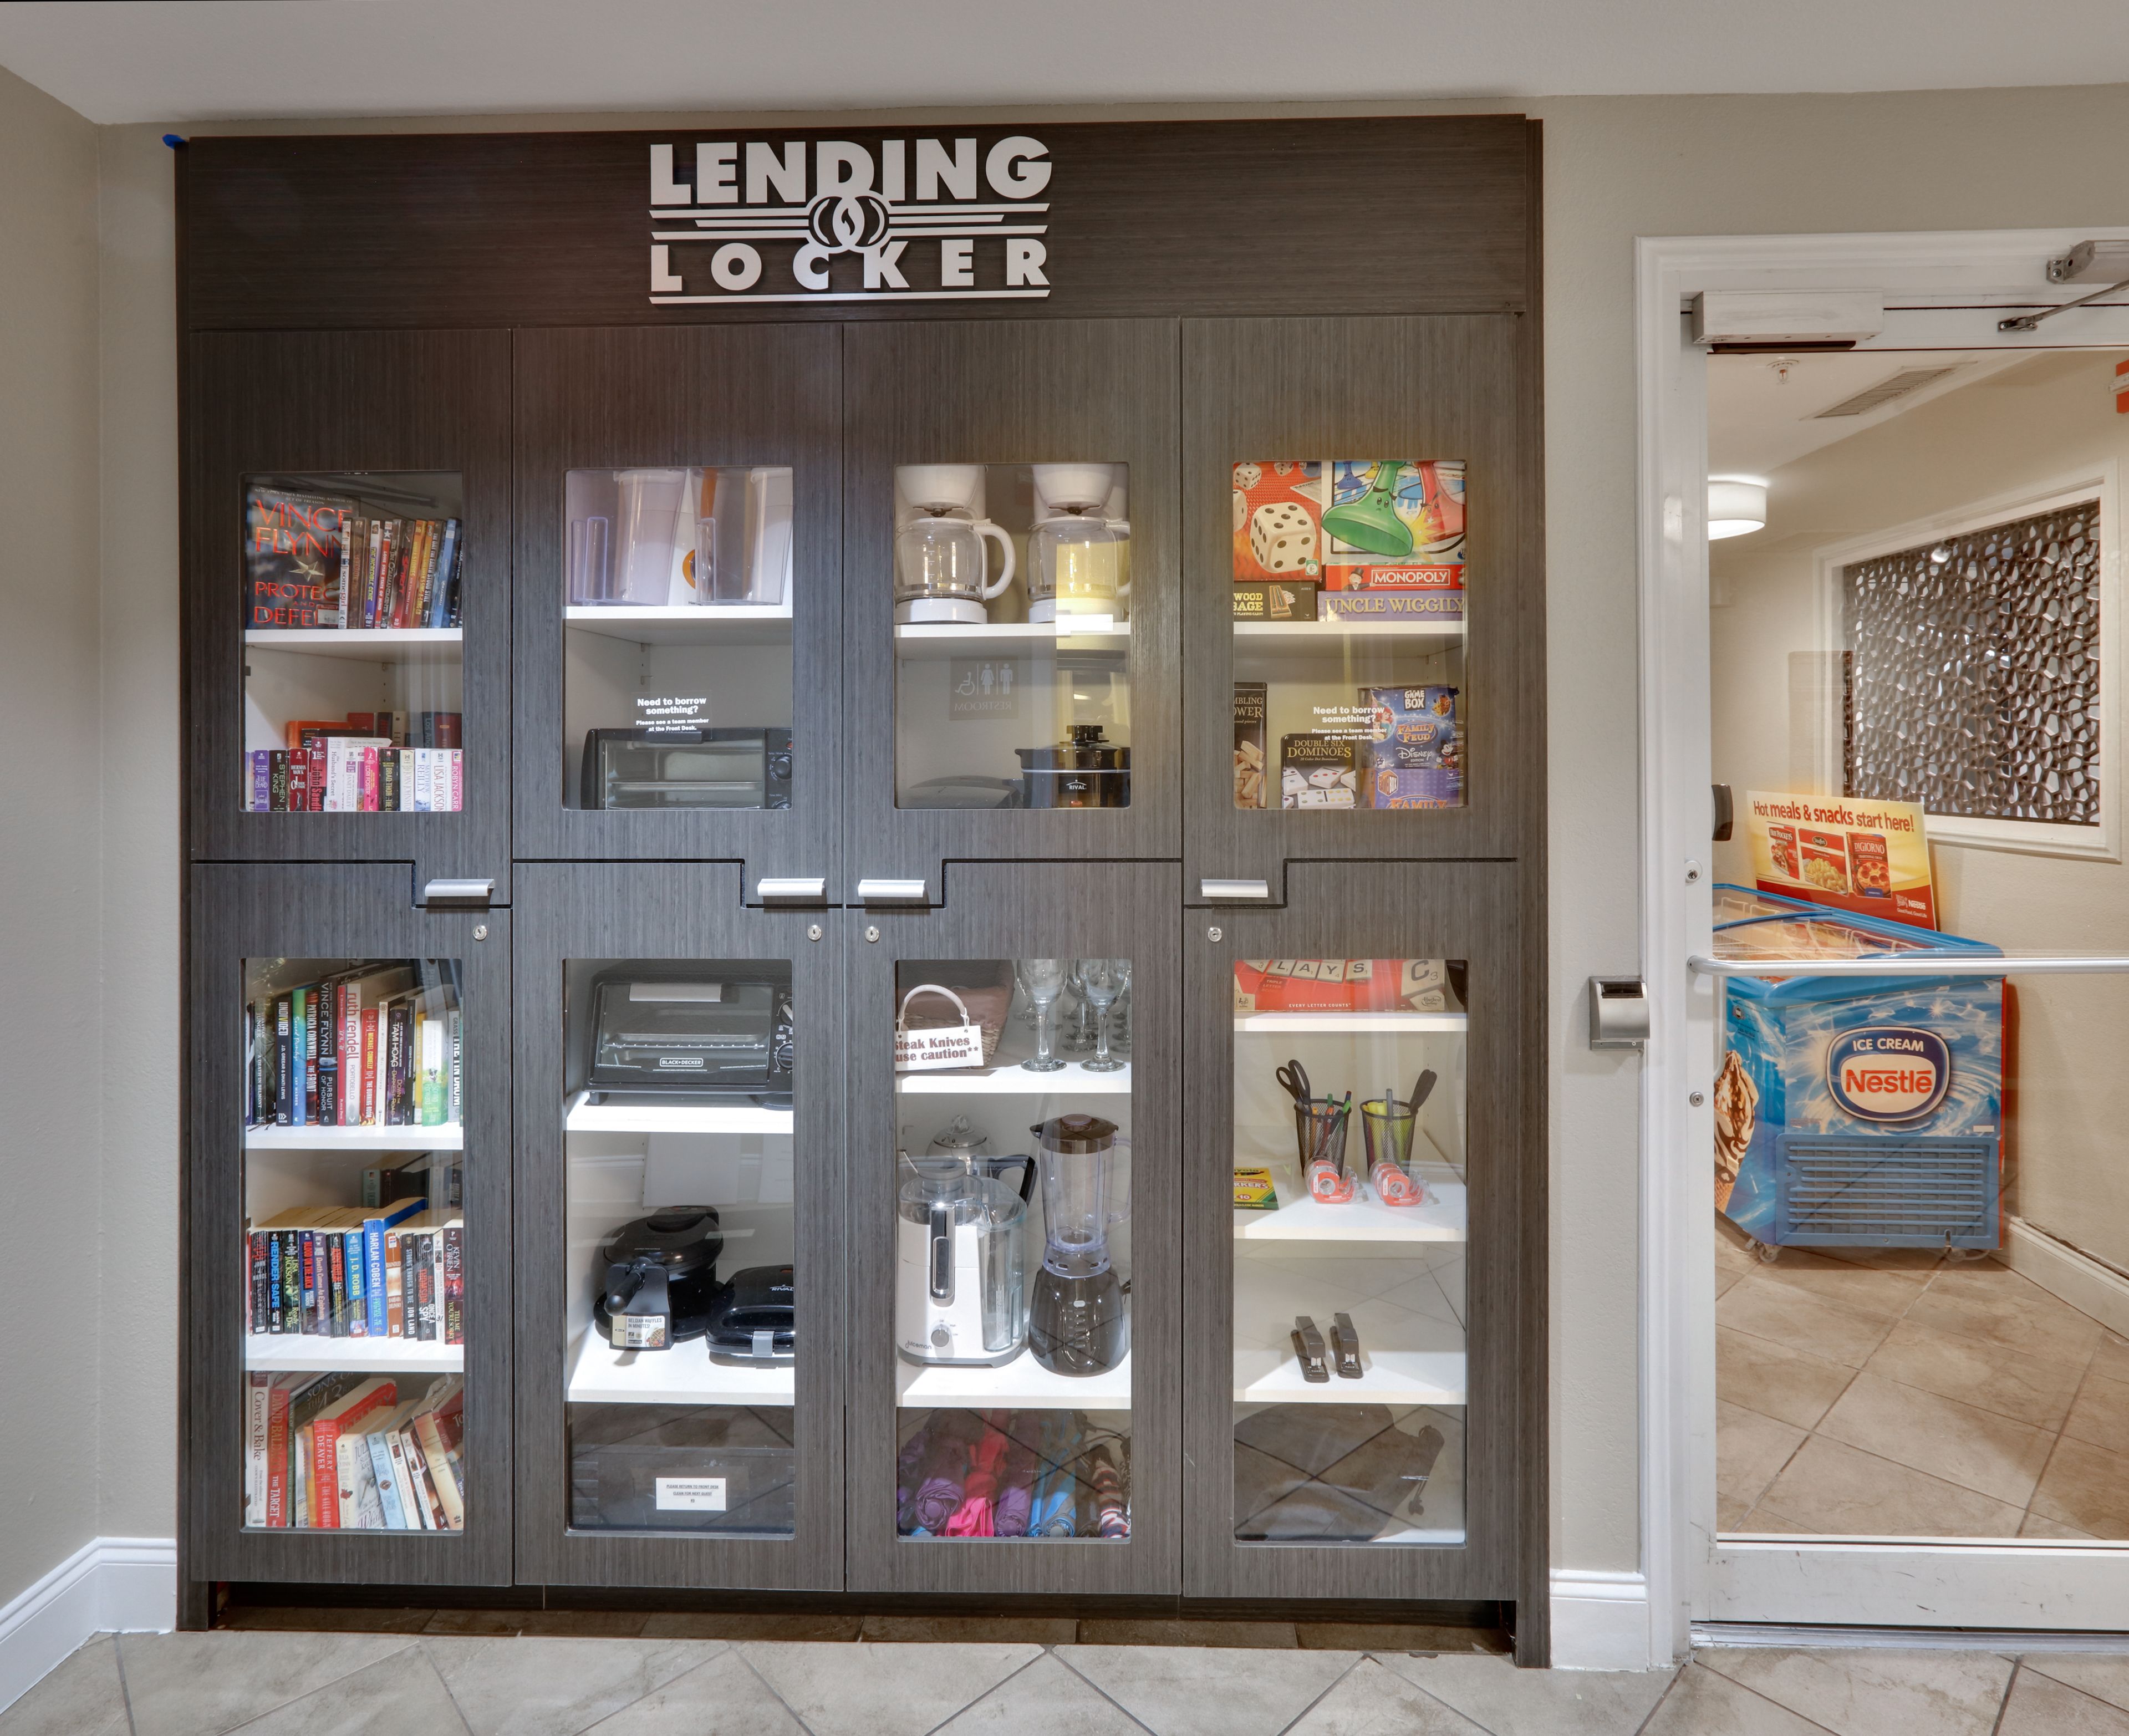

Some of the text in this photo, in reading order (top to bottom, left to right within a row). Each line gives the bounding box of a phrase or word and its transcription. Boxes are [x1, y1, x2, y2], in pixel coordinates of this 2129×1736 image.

[650, 136, 1052, 205] LENDING
[651, 237, 1051, 292] LOCKER
[425, 574, 434, 590] STOOD
[1374, 572, 1448, 584] MONOPOLY
[1234, 593, 1263, 601] WOOD
[1325, 597, 1464, 614] UNCLE WIGGILY
[638, 698, 661, 706] Need
[646, 705, 699, 715] something?
[1405, 698, 1424, 710] BOX
[1322, 715, 1376, 724] something?
[1397, 725, 1435, 735] FAMILY
[1403, 732, 1430, 742] FEUD
[1287, 746, 1352, 758] DOMINOES
[312, 767, 323, 786] John
[434, 765, 445, 811] LISA JACKSON
[1754, 800, 1914, 832] Hot meals & snacks start here!
[278, 1002, 288, 1036] UNDIVIDED
[307, 1004, 317, 1029] PATRICIA
[347, 992, 359, 1060] ruth rendell
[306, 1030, 317, 1060] CORNWELL
[320, 1020, 329, 1055] FLYNN
[929, 1036, 970, 1048] Knives
[1852, 1037, 1924, 1052] ICE CREAM
[391, 1043, 399, 1067] HOAG
[895, 1051, 916, 1062] use
[306, 1073, 317, 1092] FRONT
[320, 1076, 326, 1085] OF
[1845, 1069, 1932, 1093] Nestlé
[370, 1232, 381, 1287] HARLAN COBEN
[271, 1241, 279, 1308] RENDER SAFE
[352, 1274, 360, 1296] ROBB
[419, 1306, 429, 1321] SPY
[272, 1394, 283, 1423] DAVID
[253, 1391, 265, 1460] Cover & Bake
[269, 1488, 280, 1518] TARGET
